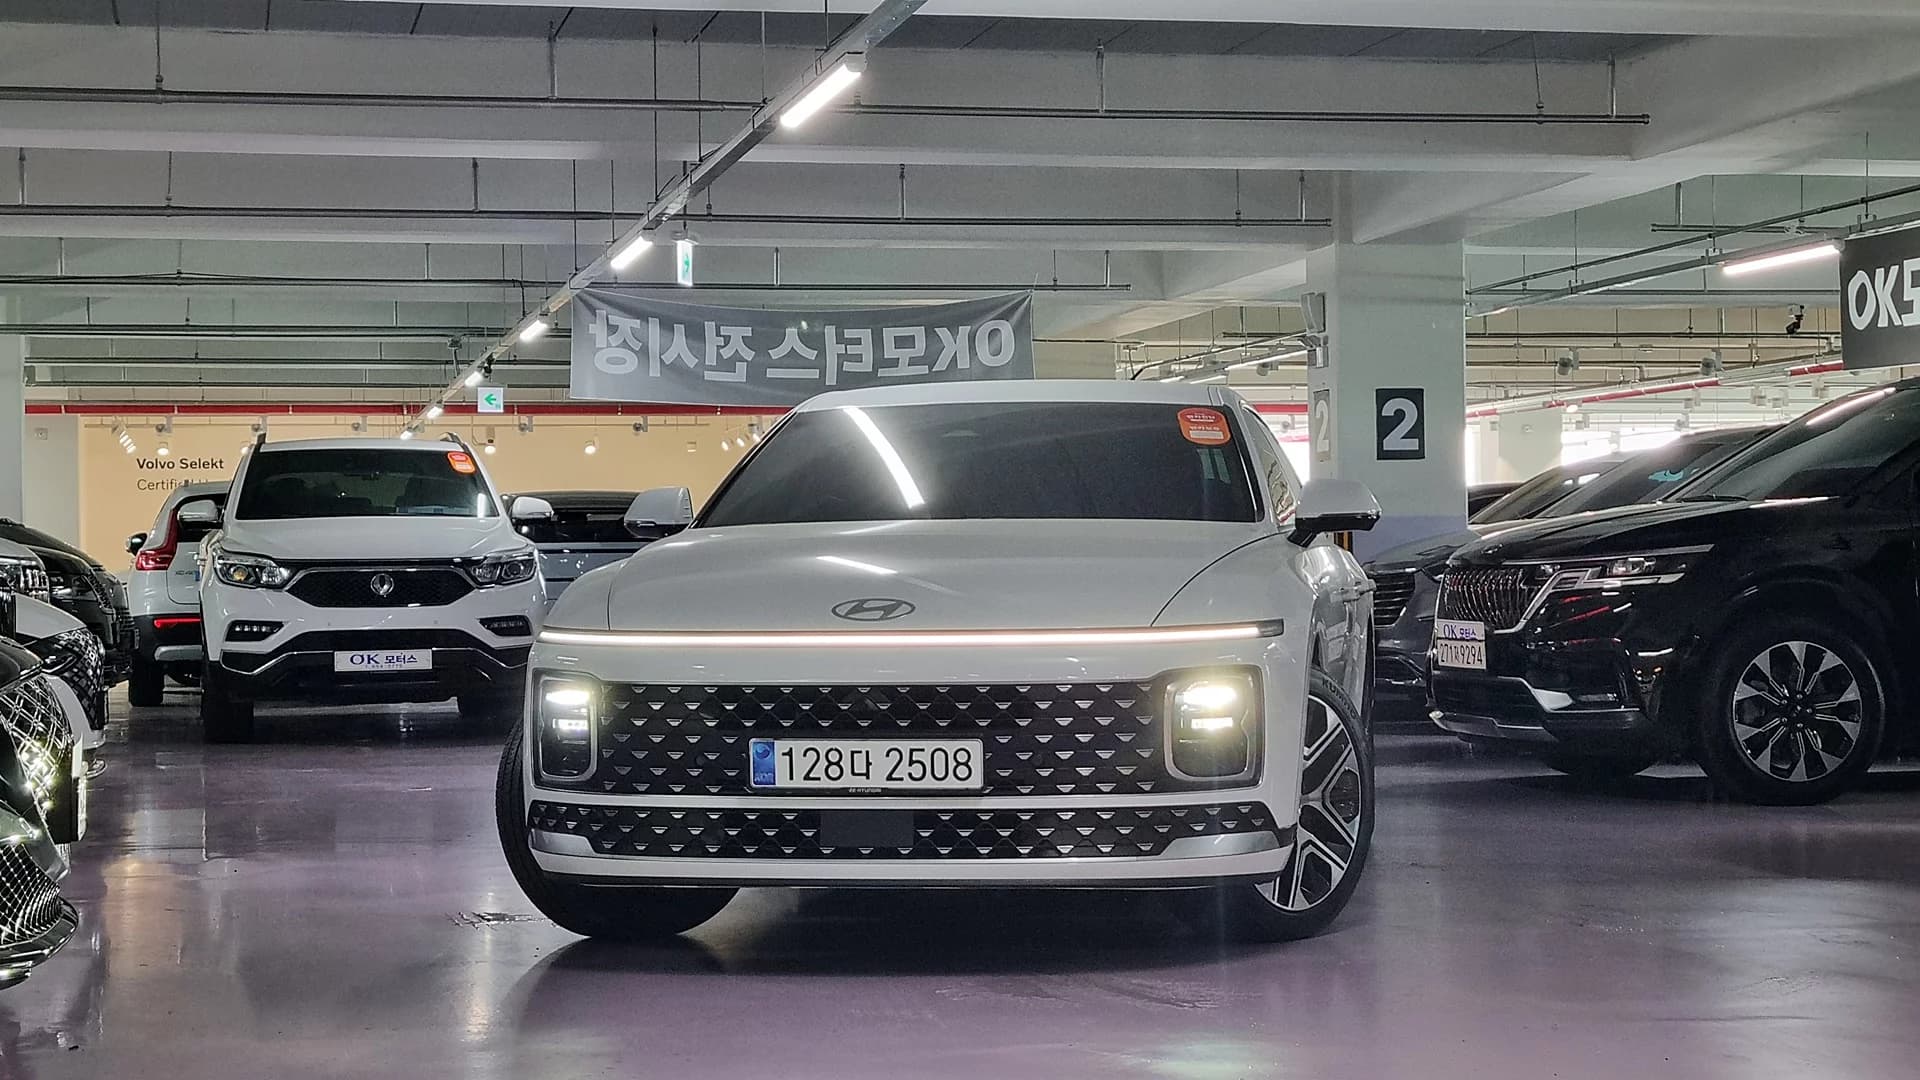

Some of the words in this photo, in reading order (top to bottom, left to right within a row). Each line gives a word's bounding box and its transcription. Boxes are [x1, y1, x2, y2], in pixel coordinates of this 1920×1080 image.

[1315, 399, 1330, 453] 2
[1381, 397, 1419, 451] 2
[136, 458, 176, 470] Volvo
[179, 457, 225, 470] Selekt
[137, 478, 193, 491] Certifi
[1443, 624, 1458, 639] OK
[349, 653, 381, 665] OK
[384, 653, 418, 664] 모터스
[781, 746, 873, 782] 128다
[885, 747, 973, 782] 2508
